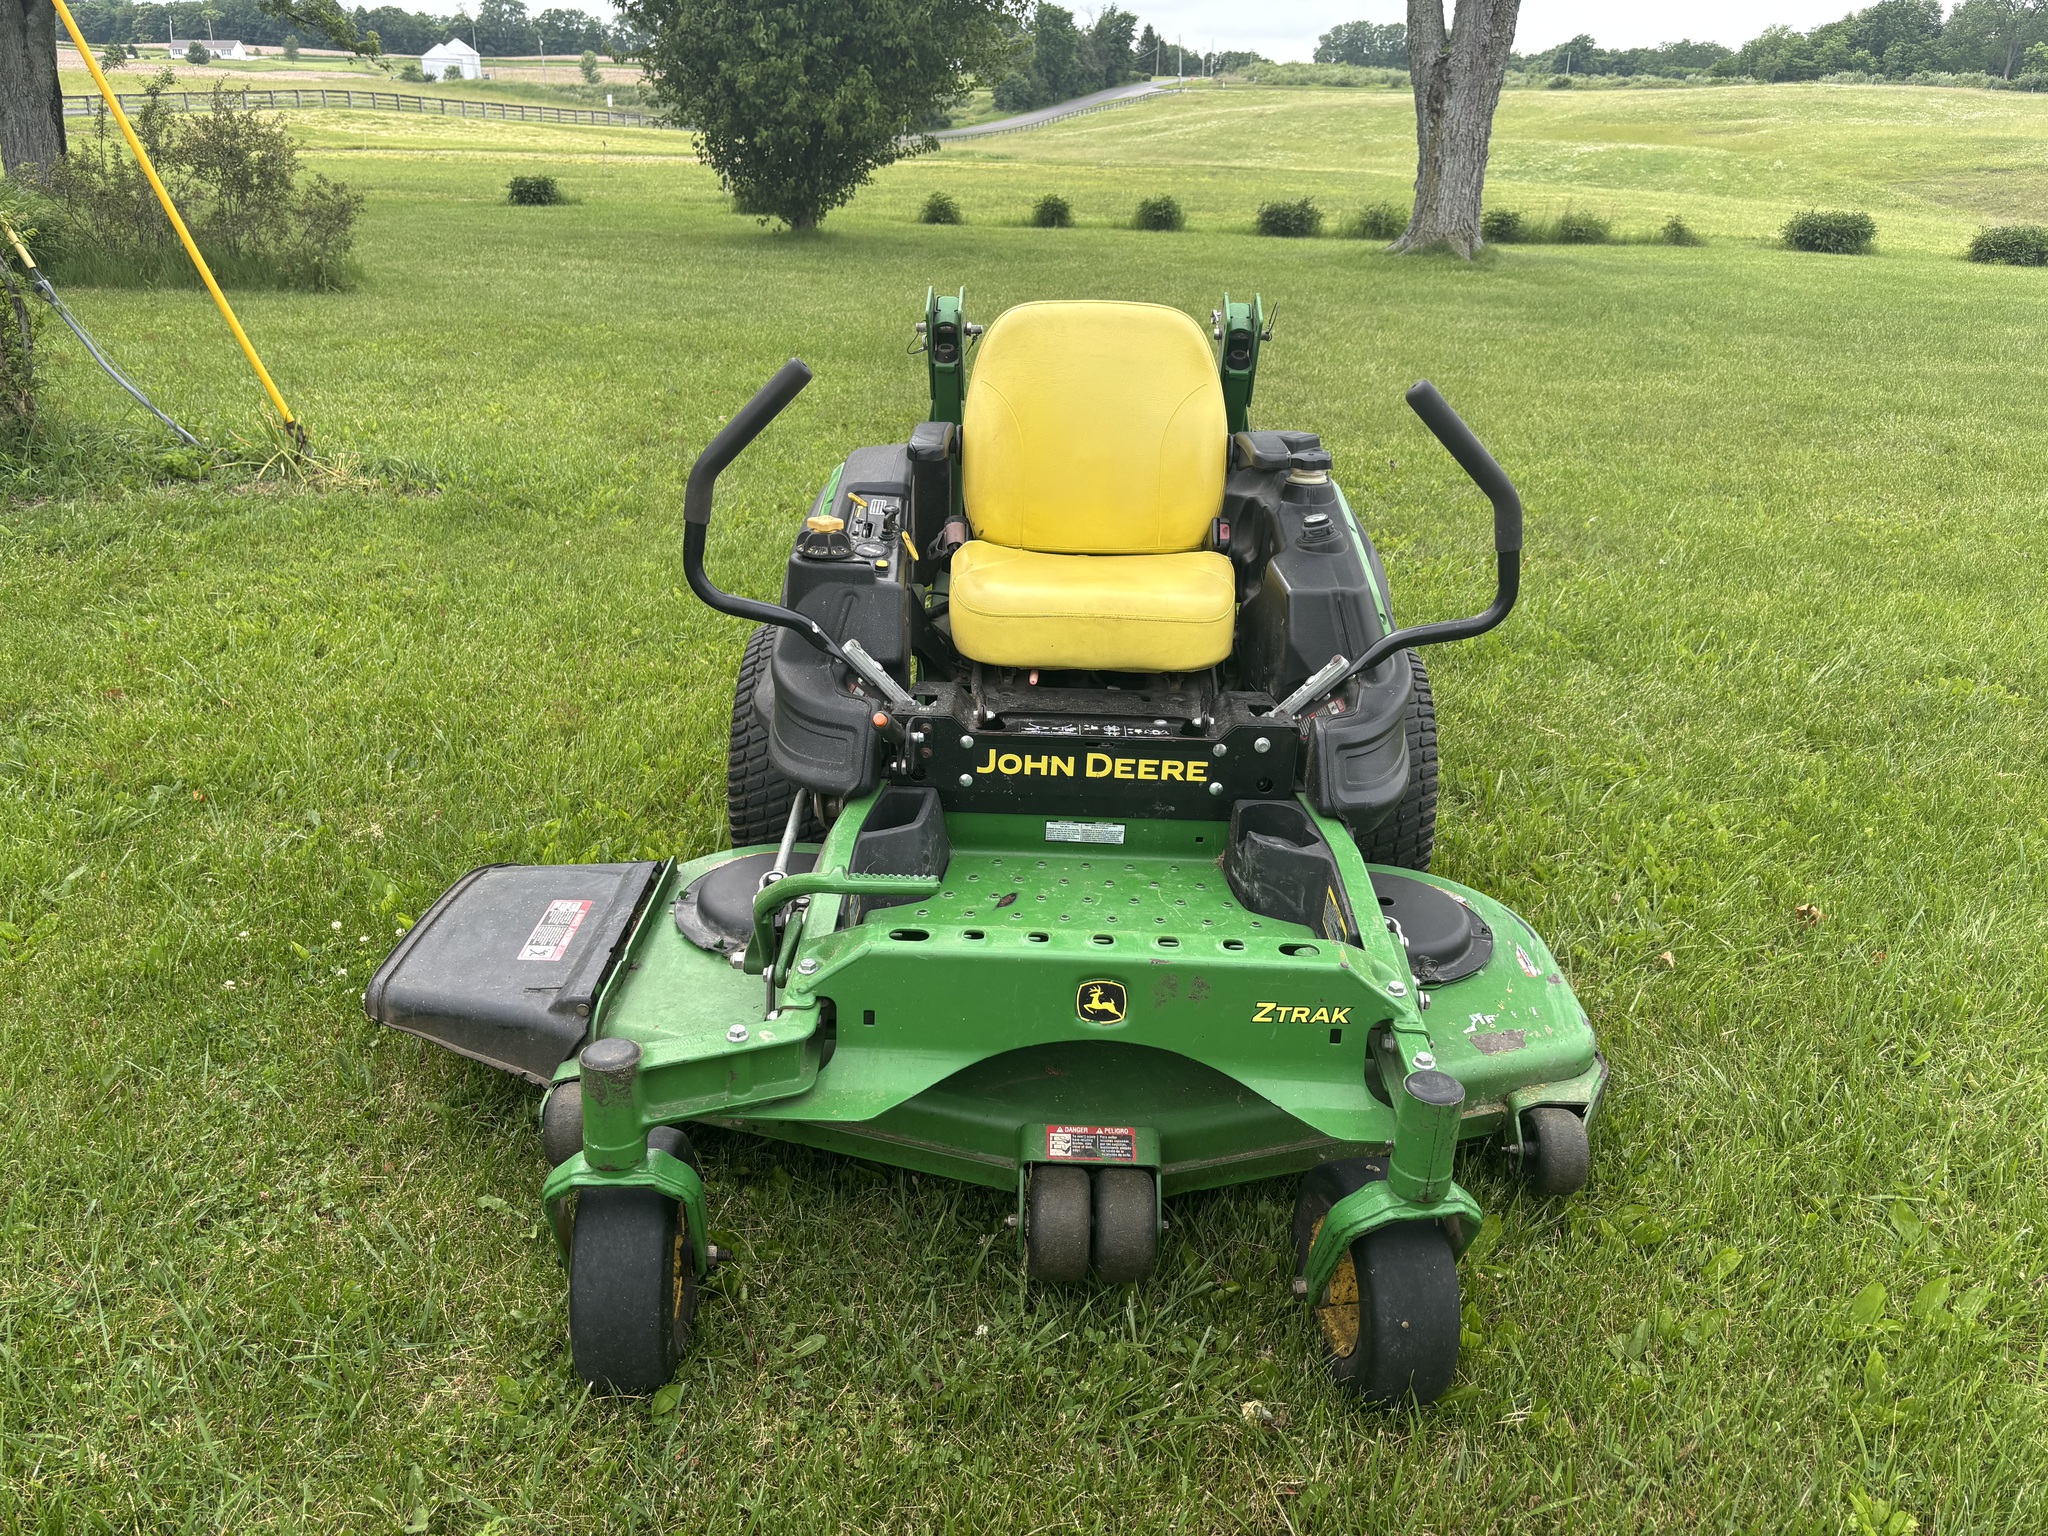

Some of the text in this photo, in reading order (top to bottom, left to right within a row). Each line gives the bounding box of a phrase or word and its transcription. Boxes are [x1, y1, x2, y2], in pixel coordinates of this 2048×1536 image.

[976, 748, 1209, 782] JOHN DEERE
[1251, 1002, 1354, 1024] ZTRAK
